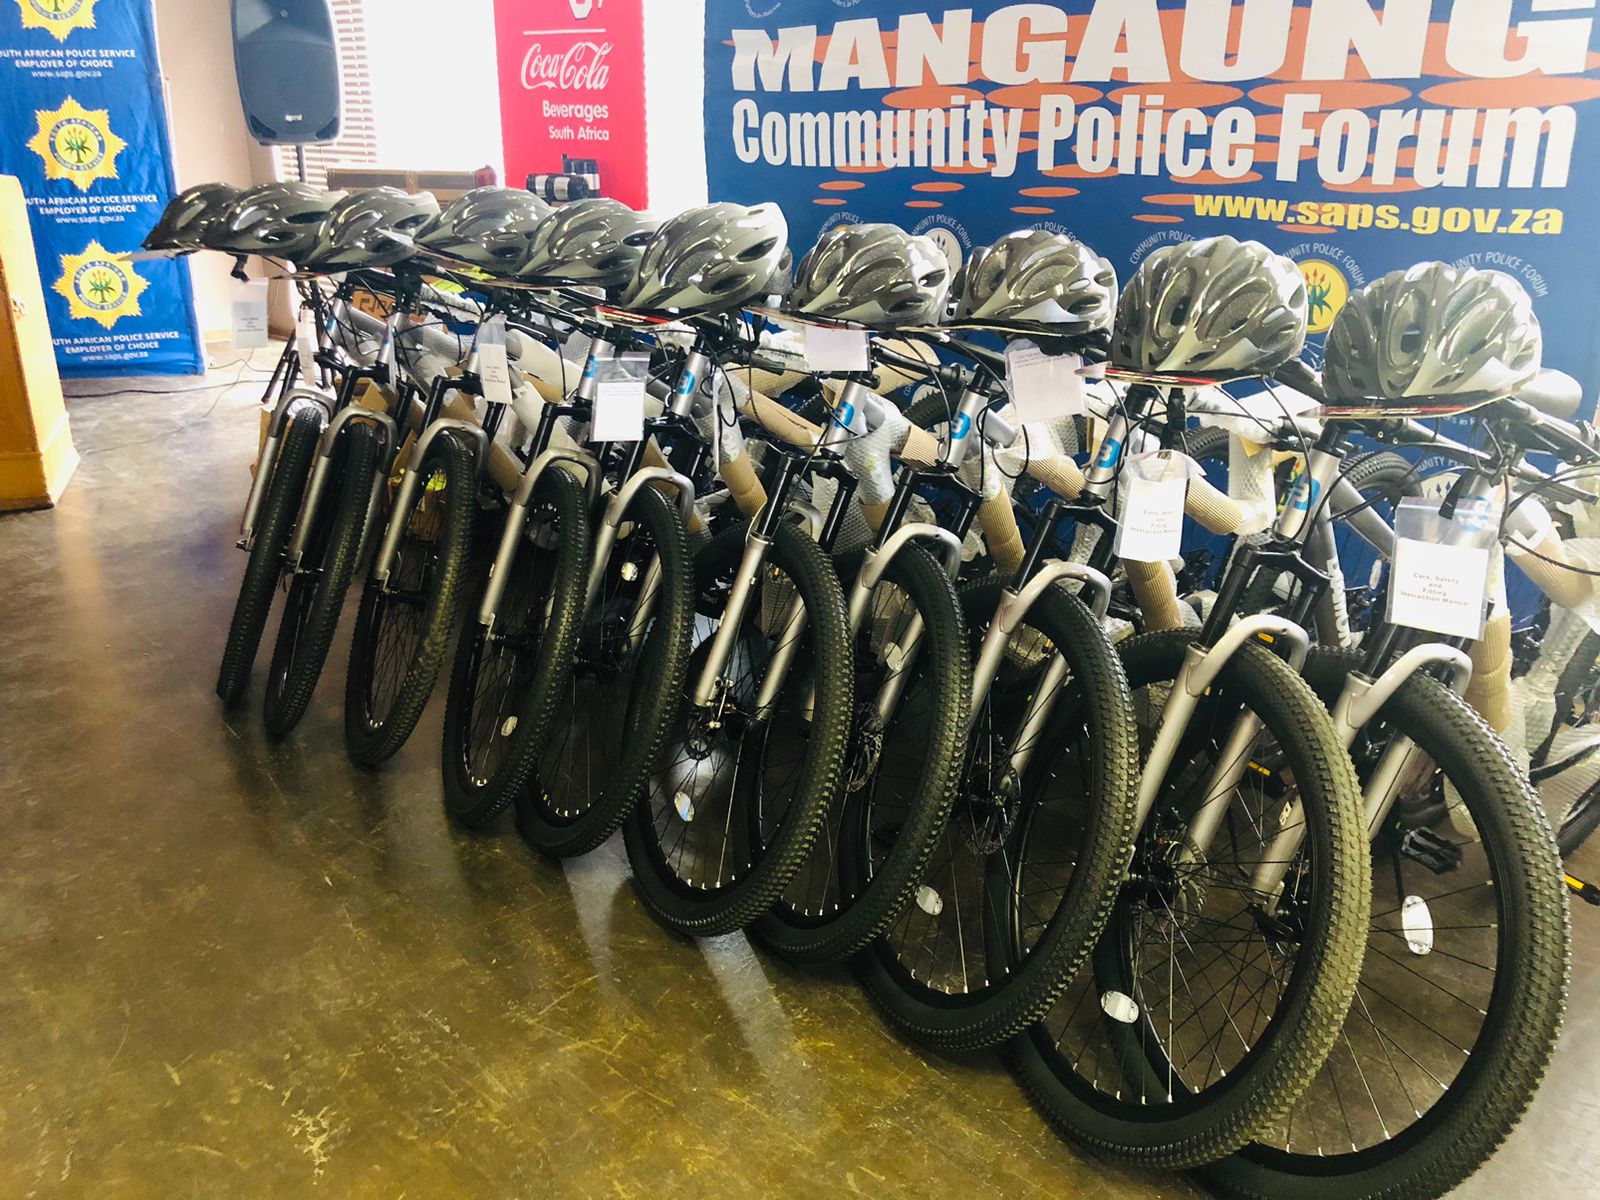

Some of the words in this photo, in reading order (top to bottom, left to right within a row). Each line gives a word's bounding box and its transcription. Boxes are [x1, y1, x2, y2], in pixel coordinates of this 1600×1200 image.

[24, 49, 64, 58] AFRICAN
[65, 49, 97, 58] POLICE
[98, 49, 137, 58] SERVICE
[731, 0, 1596, 92] MANGAUNG
[15, 59, 65, 68] EMPLOYER
[65, 59, 77, 68] OF
[79, 59, 114, 68] CHOICE
[521, 41, 614, 90] Coca-Cola
[542, 100, 609, 123] Beverages
[548, 125, 575, 140] South
[577, 125, 610, 141] Africa
[732, 95, 1024, 178] Community
[1037, 94, 1257, 179] Police
[1275, 93, 1577, 188] Forum
[25, 197, 47, 206] UTH
[48, 196, 87, 206] AFRICAN
[89, 195, 120, 204] POLICE
[121, 194, 158, 203] SERVICE
[39, 206, 88, 215] EMPLOYER
[89, 206, 101, 214] OF
[103, 205, 137, 213] CHOICE
[1193, 194, 1564, 235] www.saps.gov.za
[936, 214, 958, 229] POLICE
[955, 223, 972, 250] FORUM
[1129, 230, 1168, 265] COMMUNITY
[1312, 242, 1345, 261] POLICE
[1342, 255, 1366, 287] FORUM
[1485, 251, 1523, 271] POLICE
[1520, 264, 1550, 298] FORUM
[53, 338, 72, 346] UTH
[73, 335, 112, 345] AFRICAN
[113, 333, 144, 343] POLICE
[144, 331, 180, 340] SERVICE
[65, 344, 112, 354] EMPLOYER
[114, 343, 125, 351] OF
[127, 341, 160, 350] CHOICE
